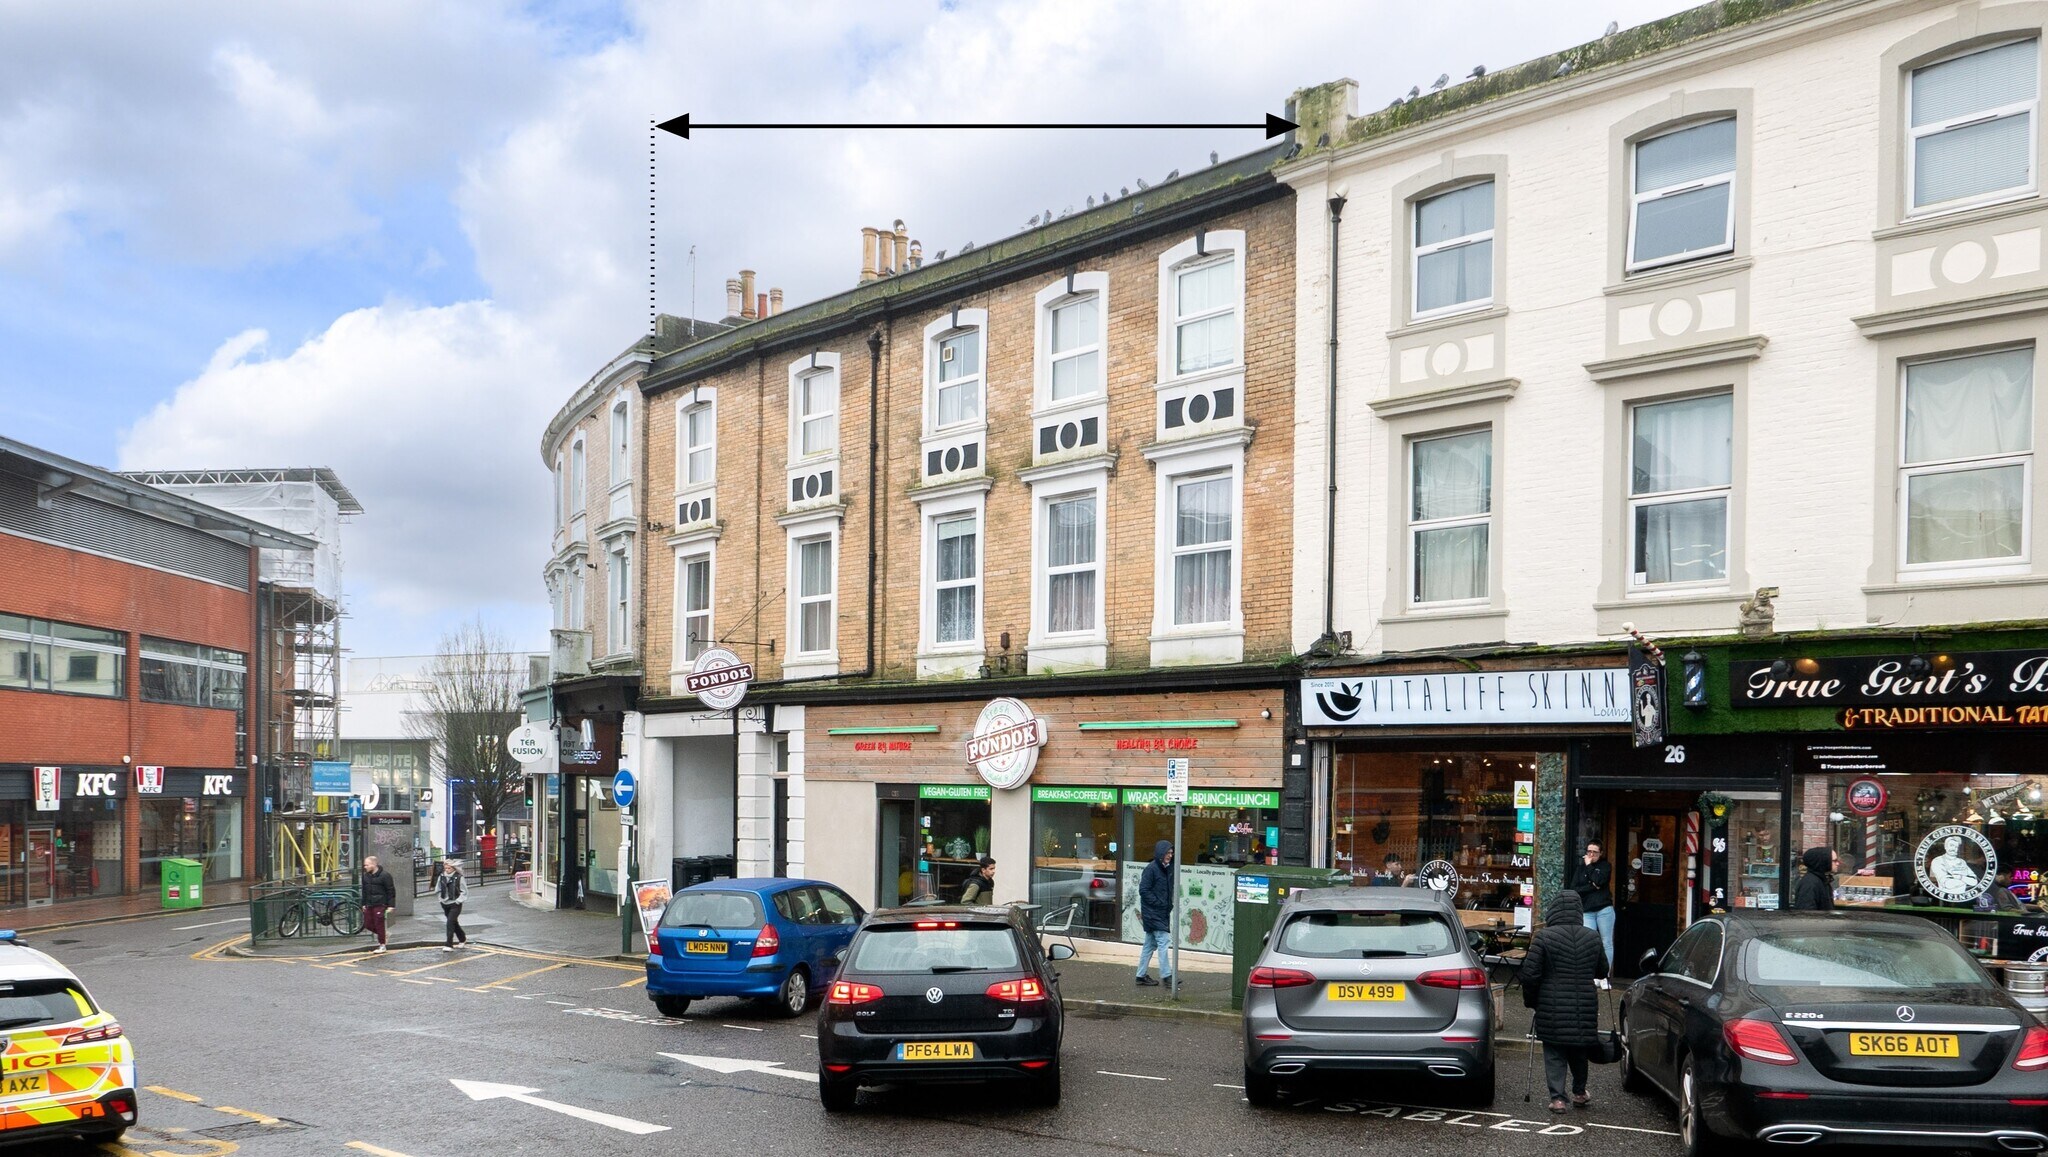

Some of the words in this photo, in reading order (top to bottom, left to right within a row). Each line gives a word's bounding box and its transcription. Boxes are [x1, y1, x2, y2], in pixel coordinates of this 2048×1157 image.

[690, 668, 750, 688] PONDOK
[1746, 667, 1846, 699] True
[1860, 659, 1993, 696] Gent's
[1371, 676, 1506, 712] VITALIFE
[1529, 672, 1630, 710] SKINN
[1593, 706, 1632, 721] Loung
[1845, 708, 1858, 728] &
[1860, 706, 2012, 726] TRADITIONAL
[855, 742, 876, 751] GREEN
[968, 720, 1037, 760] PONDOK
[1168, 737, 1198, 750] CHOICE
[1664, 745, 1685, 763] 26
[76, 773, 116, 796] KFC
[203, 775, 232, 795] KFC
[974, 788, 988, 796] FREE
[422, 791, 432, 800] JD
[1128, 792, 1158, 804] WRAPS
[1192, 793, 1232, 805] BRUNCH
[1236, 794, 1270, 806] LUNCH
[1884, 819, 1904, 830] OPEN
[1918, 837, 1933, 859] TRUE
[1932, 827, 1963, 838] GENTS
[1965, 828, 1995, 862] BARBERS
[1482, 872, 1500, 884] Tea
[2013, 924, 2034, 936] True
[1338, 984, 1366, 999] DSV
[1368, 984, 1394, 999] 499
[906, 1044, 941, 1057] PF64
[944, 1044, 970, 1056] LWA
[1858, 1036, 1908, 1052] SK66
[10, 1077, 40, 1092] AXZ
